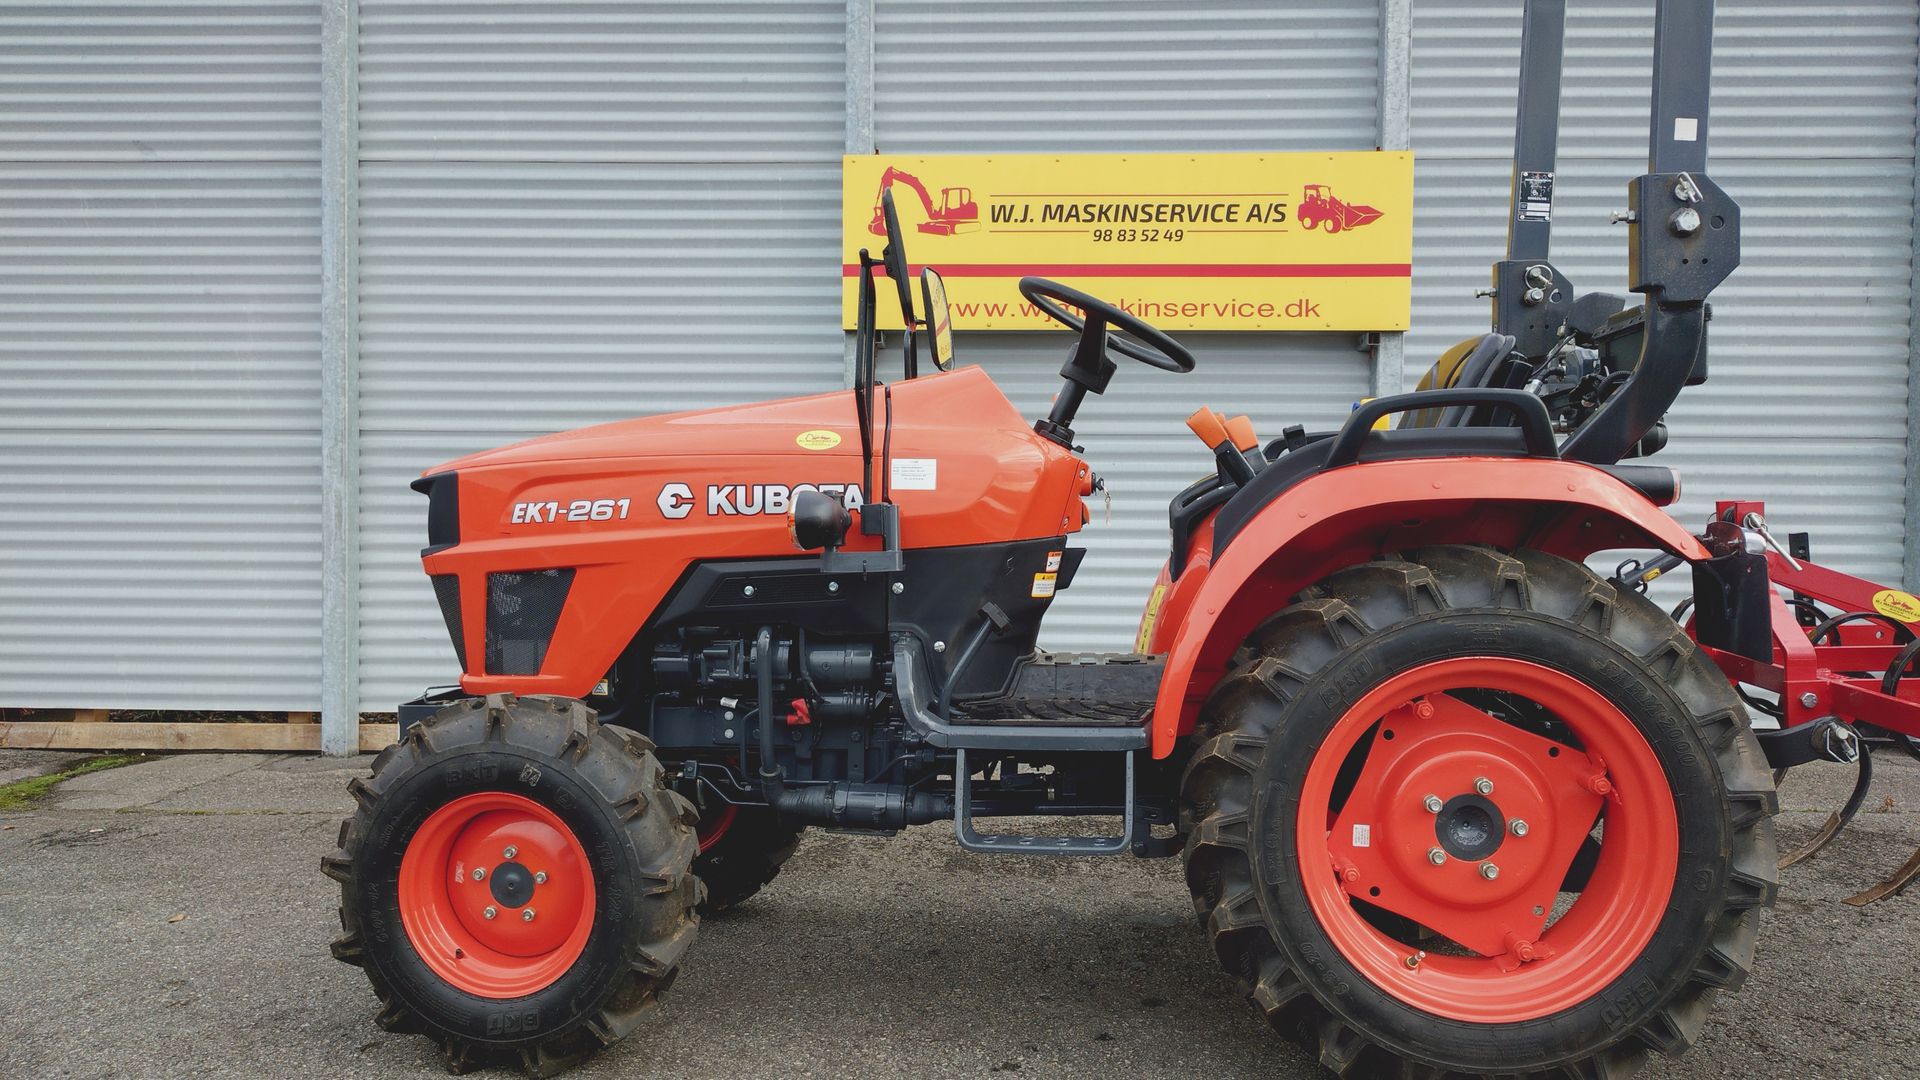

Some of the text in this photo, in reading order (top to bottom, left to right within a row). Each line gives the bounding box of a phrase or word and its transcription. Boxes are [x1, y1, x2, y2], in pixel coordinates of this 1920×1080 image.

[991, 203, 1287, 223] W.J. MASKINSERVICE A/S
[1093, 229, 1184, 242] 98 83 52 49
[950, 298, 1320, 323] ww.wmkinservice.dk
[511, 498, 631, 524] EK1-261
